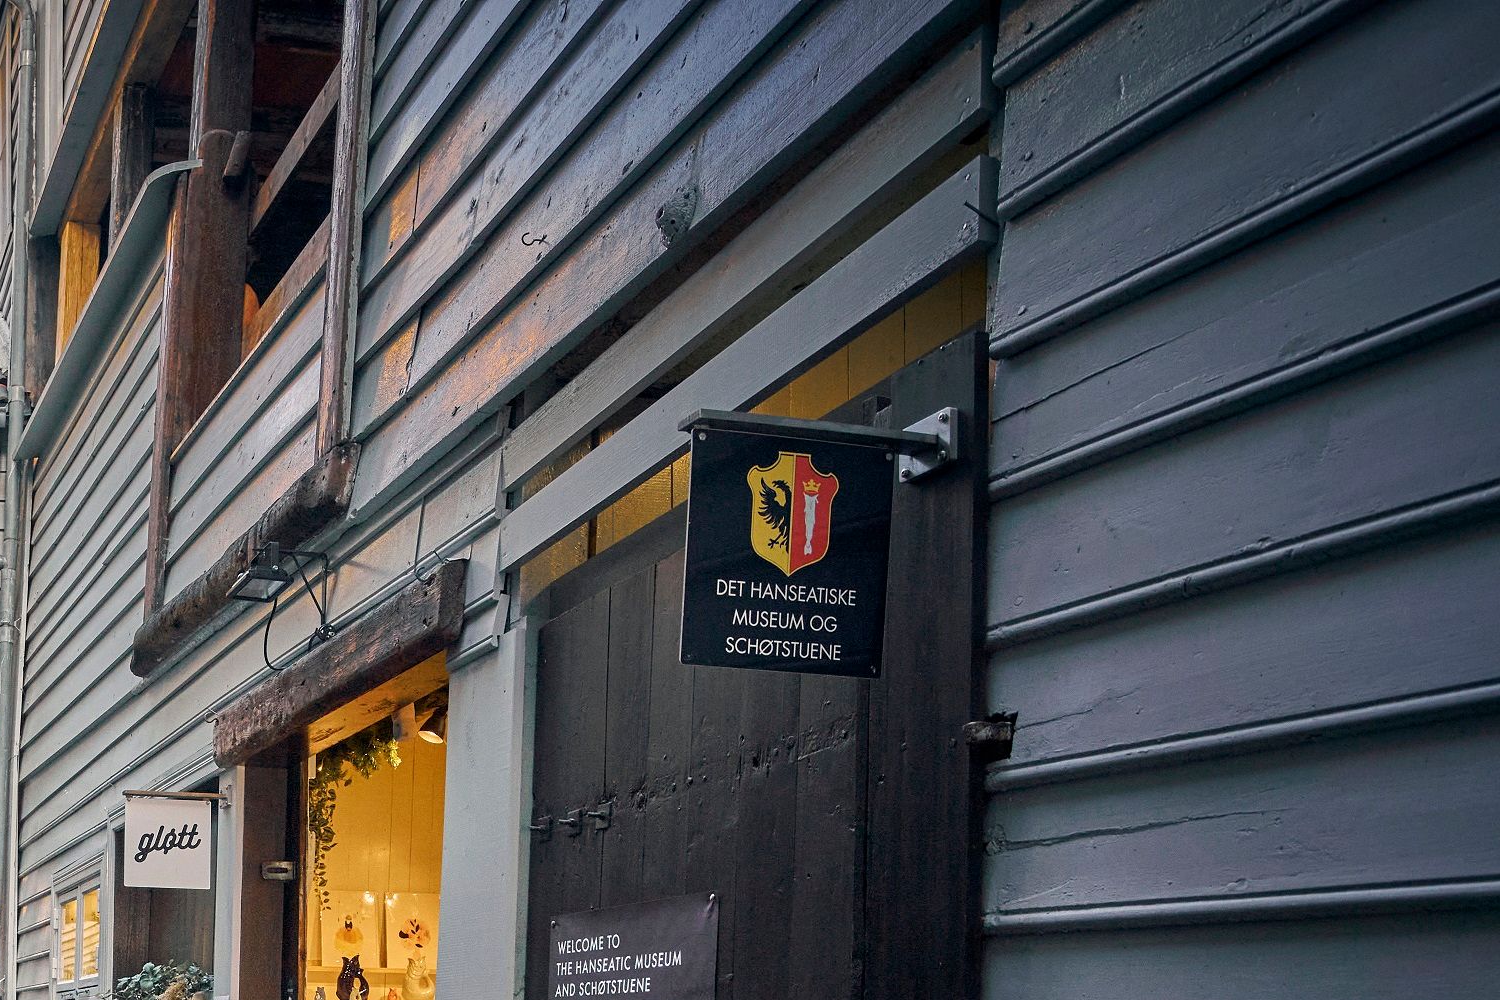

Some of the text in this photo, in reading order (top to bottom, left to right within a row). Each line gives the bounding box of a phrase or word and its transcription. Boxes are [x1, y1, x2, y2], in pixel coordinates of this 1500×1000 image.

[716, 579, 857, 606] DET HANSEATISKE
[732, 609, 838, 633] MUSEUM OG
[725, 637, 842, 661] SCHØTSTUENE
[134, 823, 202, 862] gløtt
[557, 934, 620, 955] WELCOME TO
[556, 950, 682, 976] THE HANSEATIC MUSEUM
[555, 977, 651, 998] AND SCHØTSTUENE
